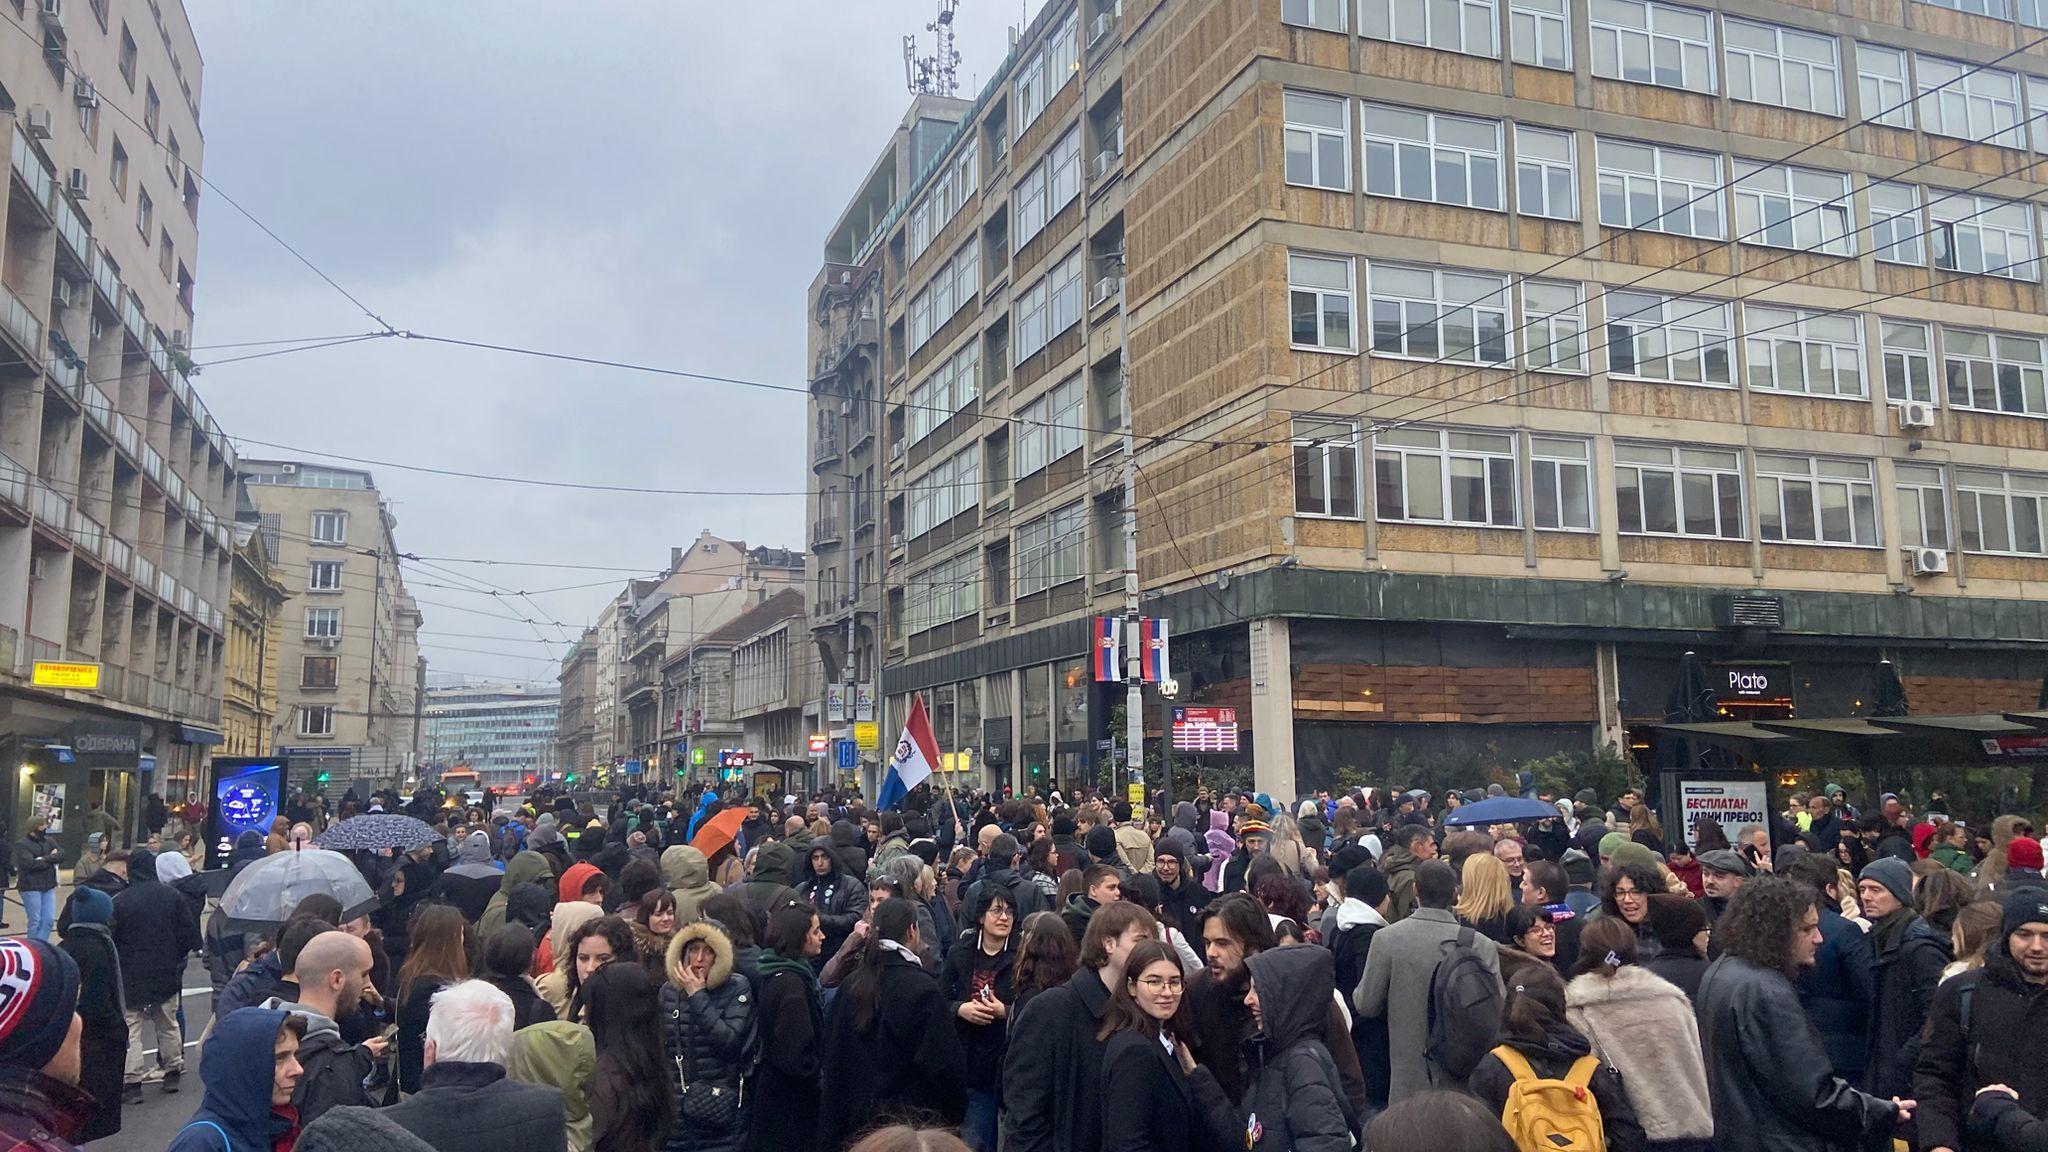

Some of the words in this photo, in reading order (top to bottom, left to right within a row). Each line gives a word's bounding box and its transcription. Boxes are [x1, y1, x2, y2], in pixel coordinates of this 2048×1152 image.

[1729, 671, 1768, 689] Plato
[1686, 798, 1748, 809] БЕСПЛАТАН
[1723, 812, 1763, 823] ПРЕВОЗ
